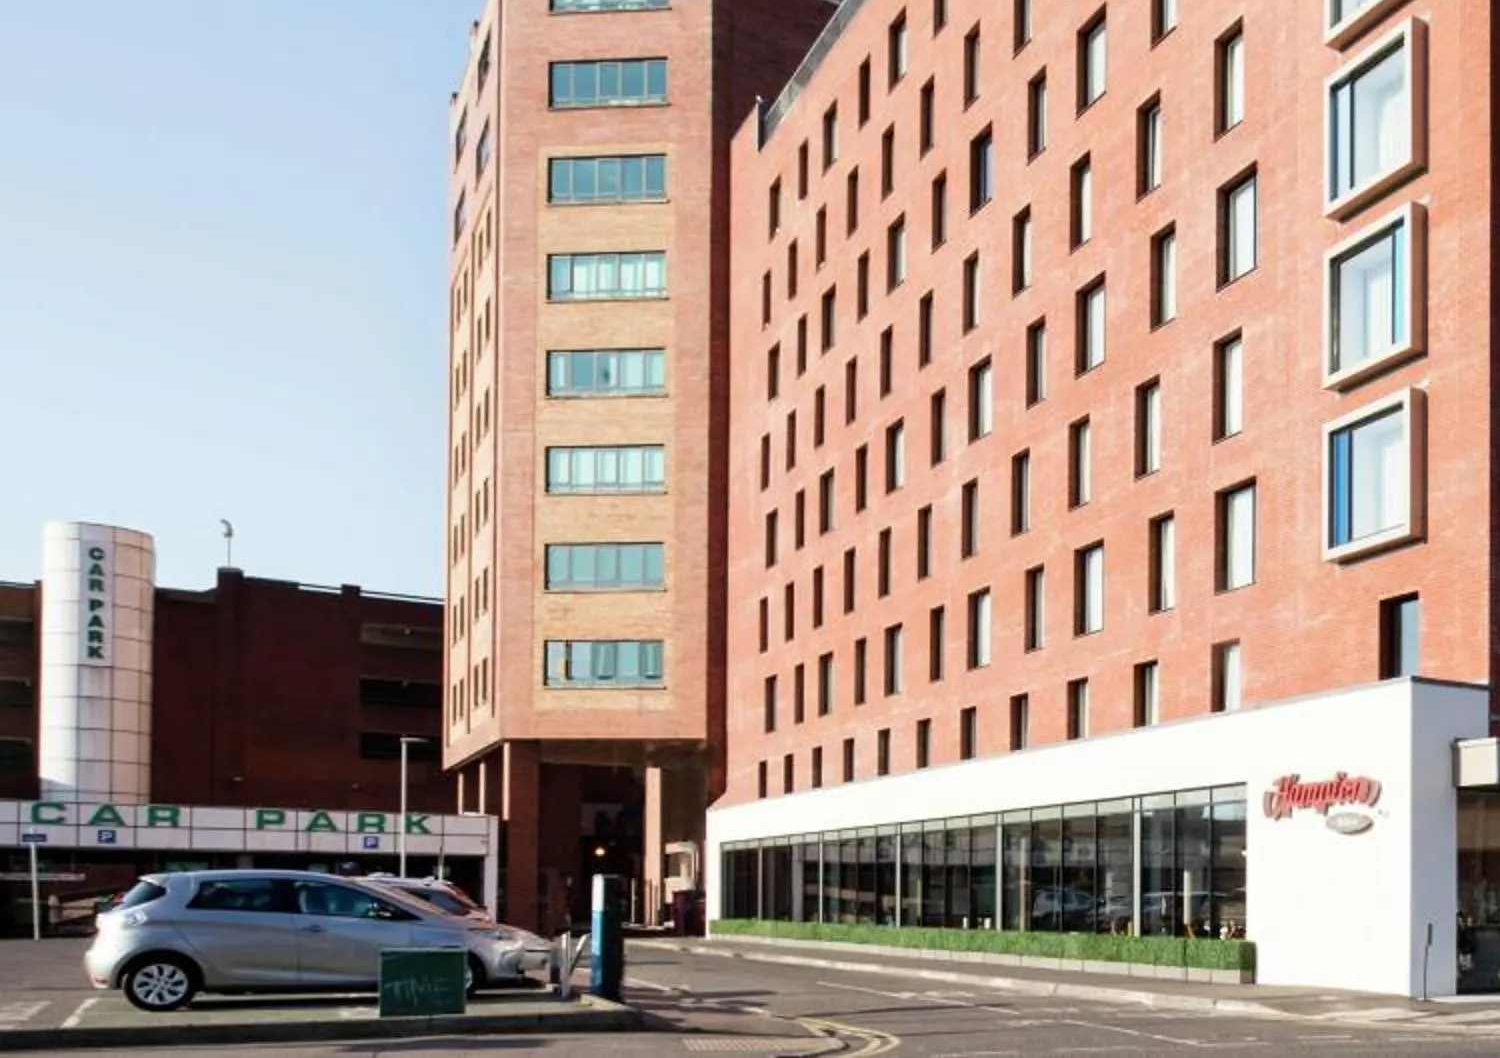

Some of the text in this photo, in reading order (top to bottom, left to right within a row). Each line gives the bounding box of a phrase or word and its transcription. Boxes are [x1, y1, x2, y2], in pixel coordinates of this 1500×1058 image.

[87, 546, 105, 659] CAR PARK
[31, 802, 432, 834] CAR PARK
[1263, 772, 1382, 821] Hampton
